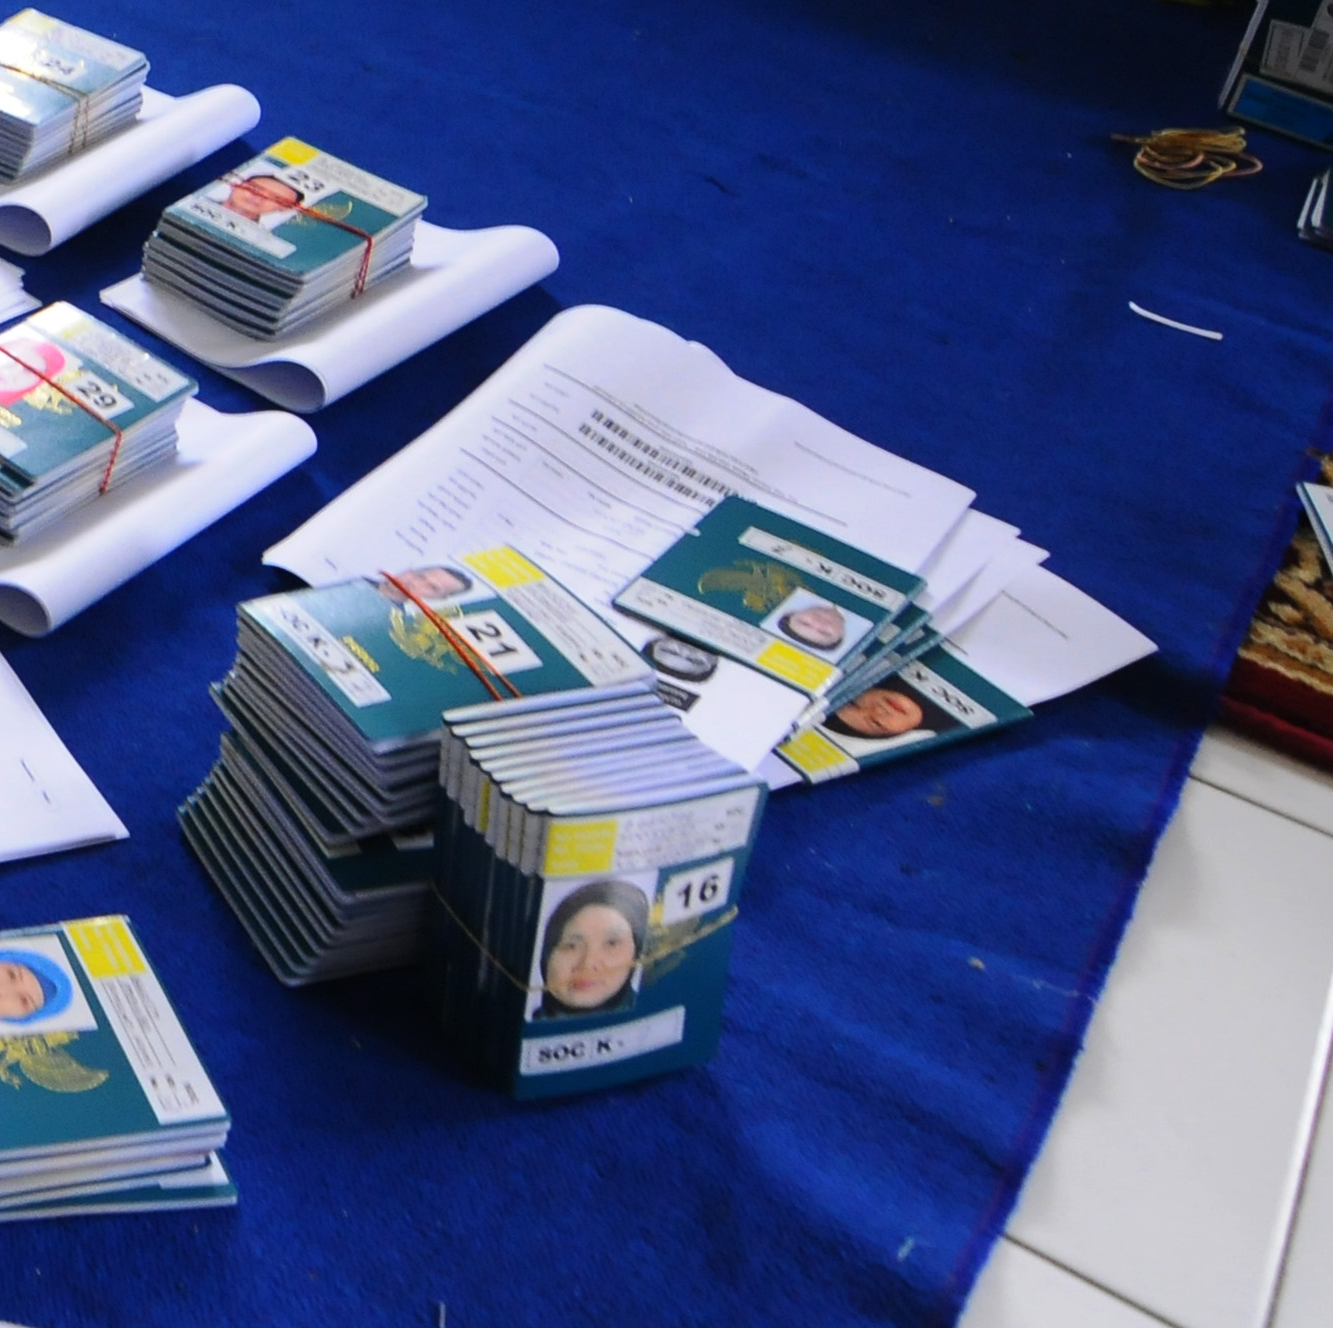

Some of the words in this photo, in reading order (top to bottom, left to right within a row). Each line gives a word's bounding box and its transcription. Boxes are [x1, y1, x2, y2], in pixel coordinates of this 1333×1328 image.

[287, 169, 326, 193] 23
[77, 380, 119, 409] 29
[465, 621, 519, 658] 21
[676, 872, 721, 908] 16
[537, 1041, 586, 1064] SOC
